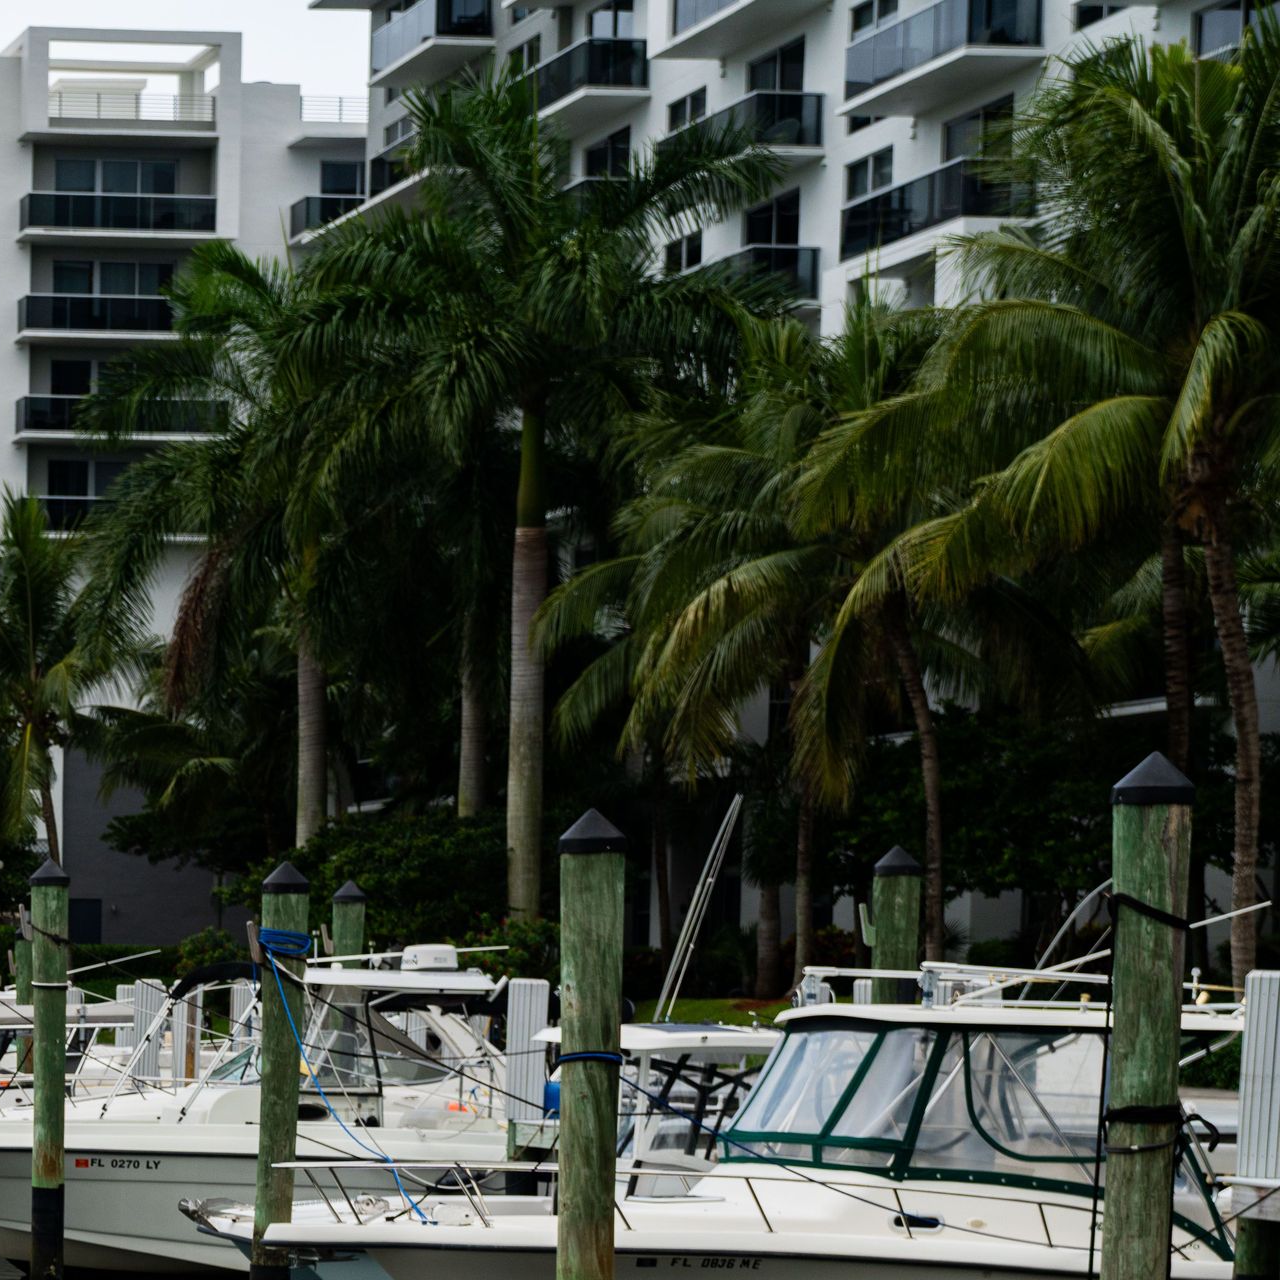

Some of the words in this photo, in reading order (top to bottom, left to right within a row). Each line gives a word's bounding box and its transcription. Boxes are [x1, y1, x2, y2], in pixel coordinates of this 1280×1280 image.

[90, 1158, 105, 1168] FL
[110, 1159, 140, 1169] 0270
[145, 1160, 161, 1170] LY
[670, 1258, 692, 1268] FL
